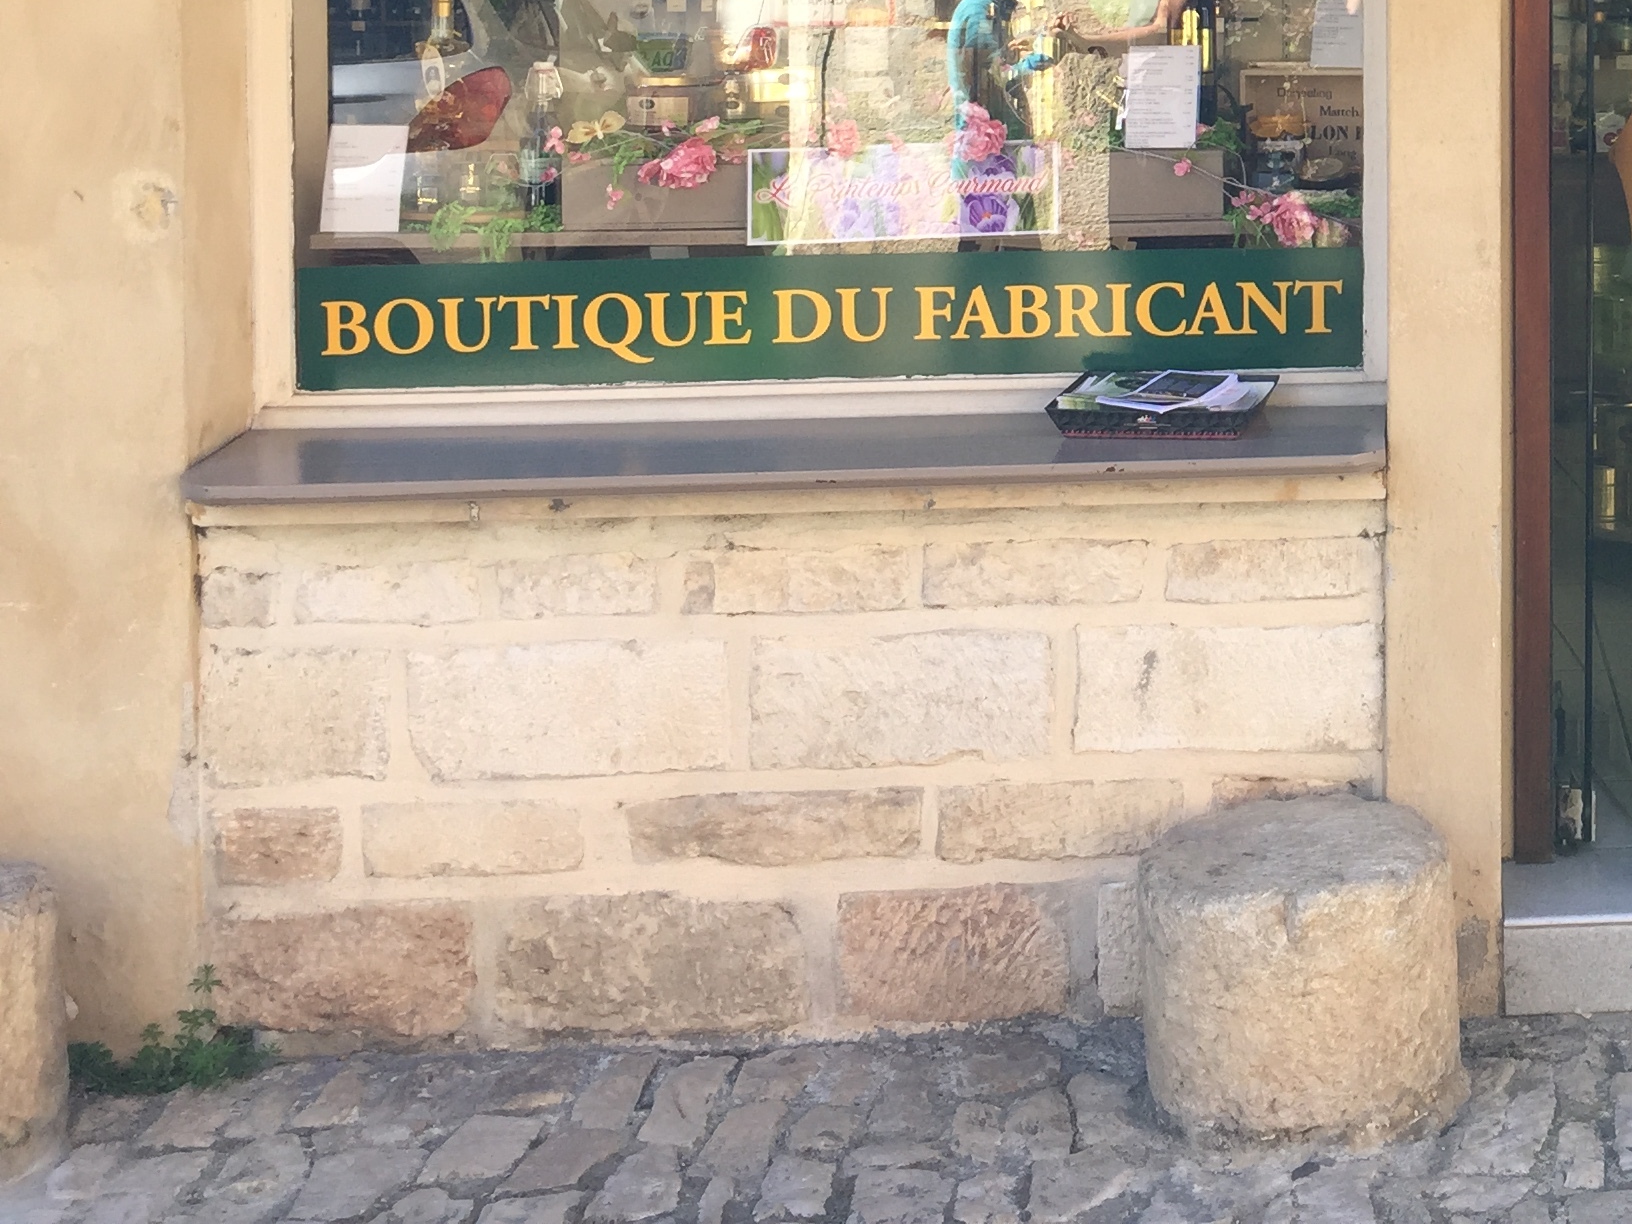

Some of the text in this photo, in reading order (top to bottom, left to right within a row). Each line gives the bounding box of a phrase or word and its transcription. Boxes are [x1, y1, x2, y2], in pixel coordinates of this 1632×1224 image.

[320, 278, 1343, 364] BOUTIQUE DU FABRICANT
